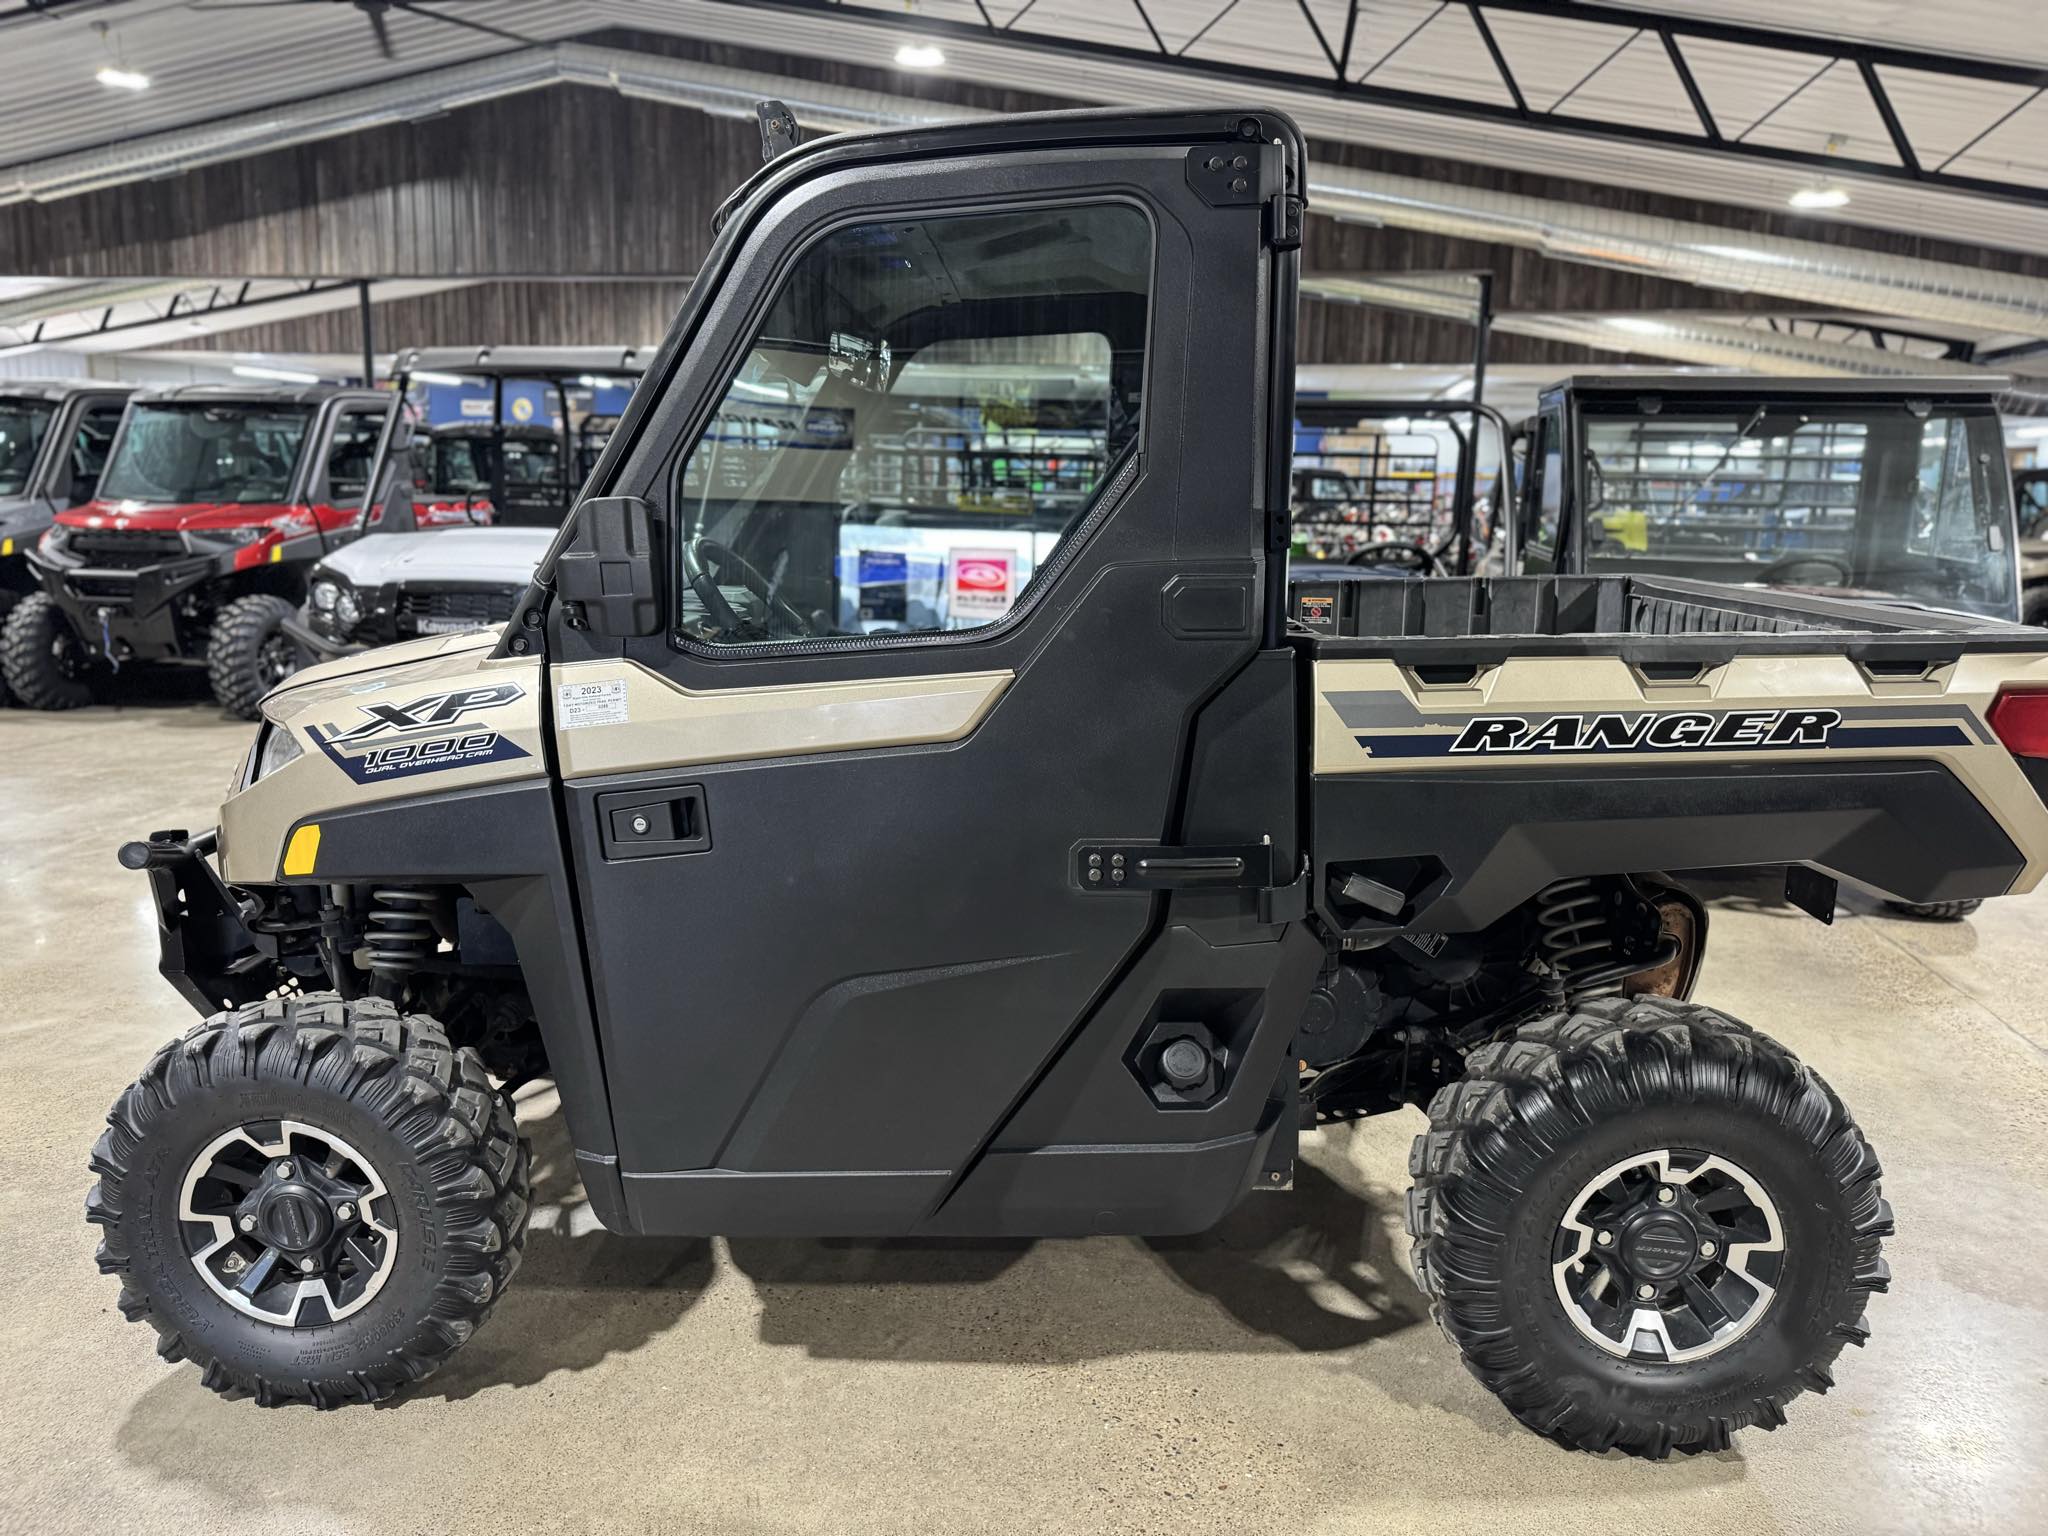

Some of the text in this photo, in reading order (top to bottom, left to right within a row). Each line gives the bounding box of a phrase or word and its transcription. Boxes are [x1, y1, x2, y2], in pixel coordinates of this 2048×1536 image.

[324, 681, 527, 743] XP
[581, 686, 602, 700] 2023
[363, 730, 498, 768] 1000
[1449, 708, 1841, 752] RANGER
[365, 749, 493, 774] DUAL OVERHEAD CAM
